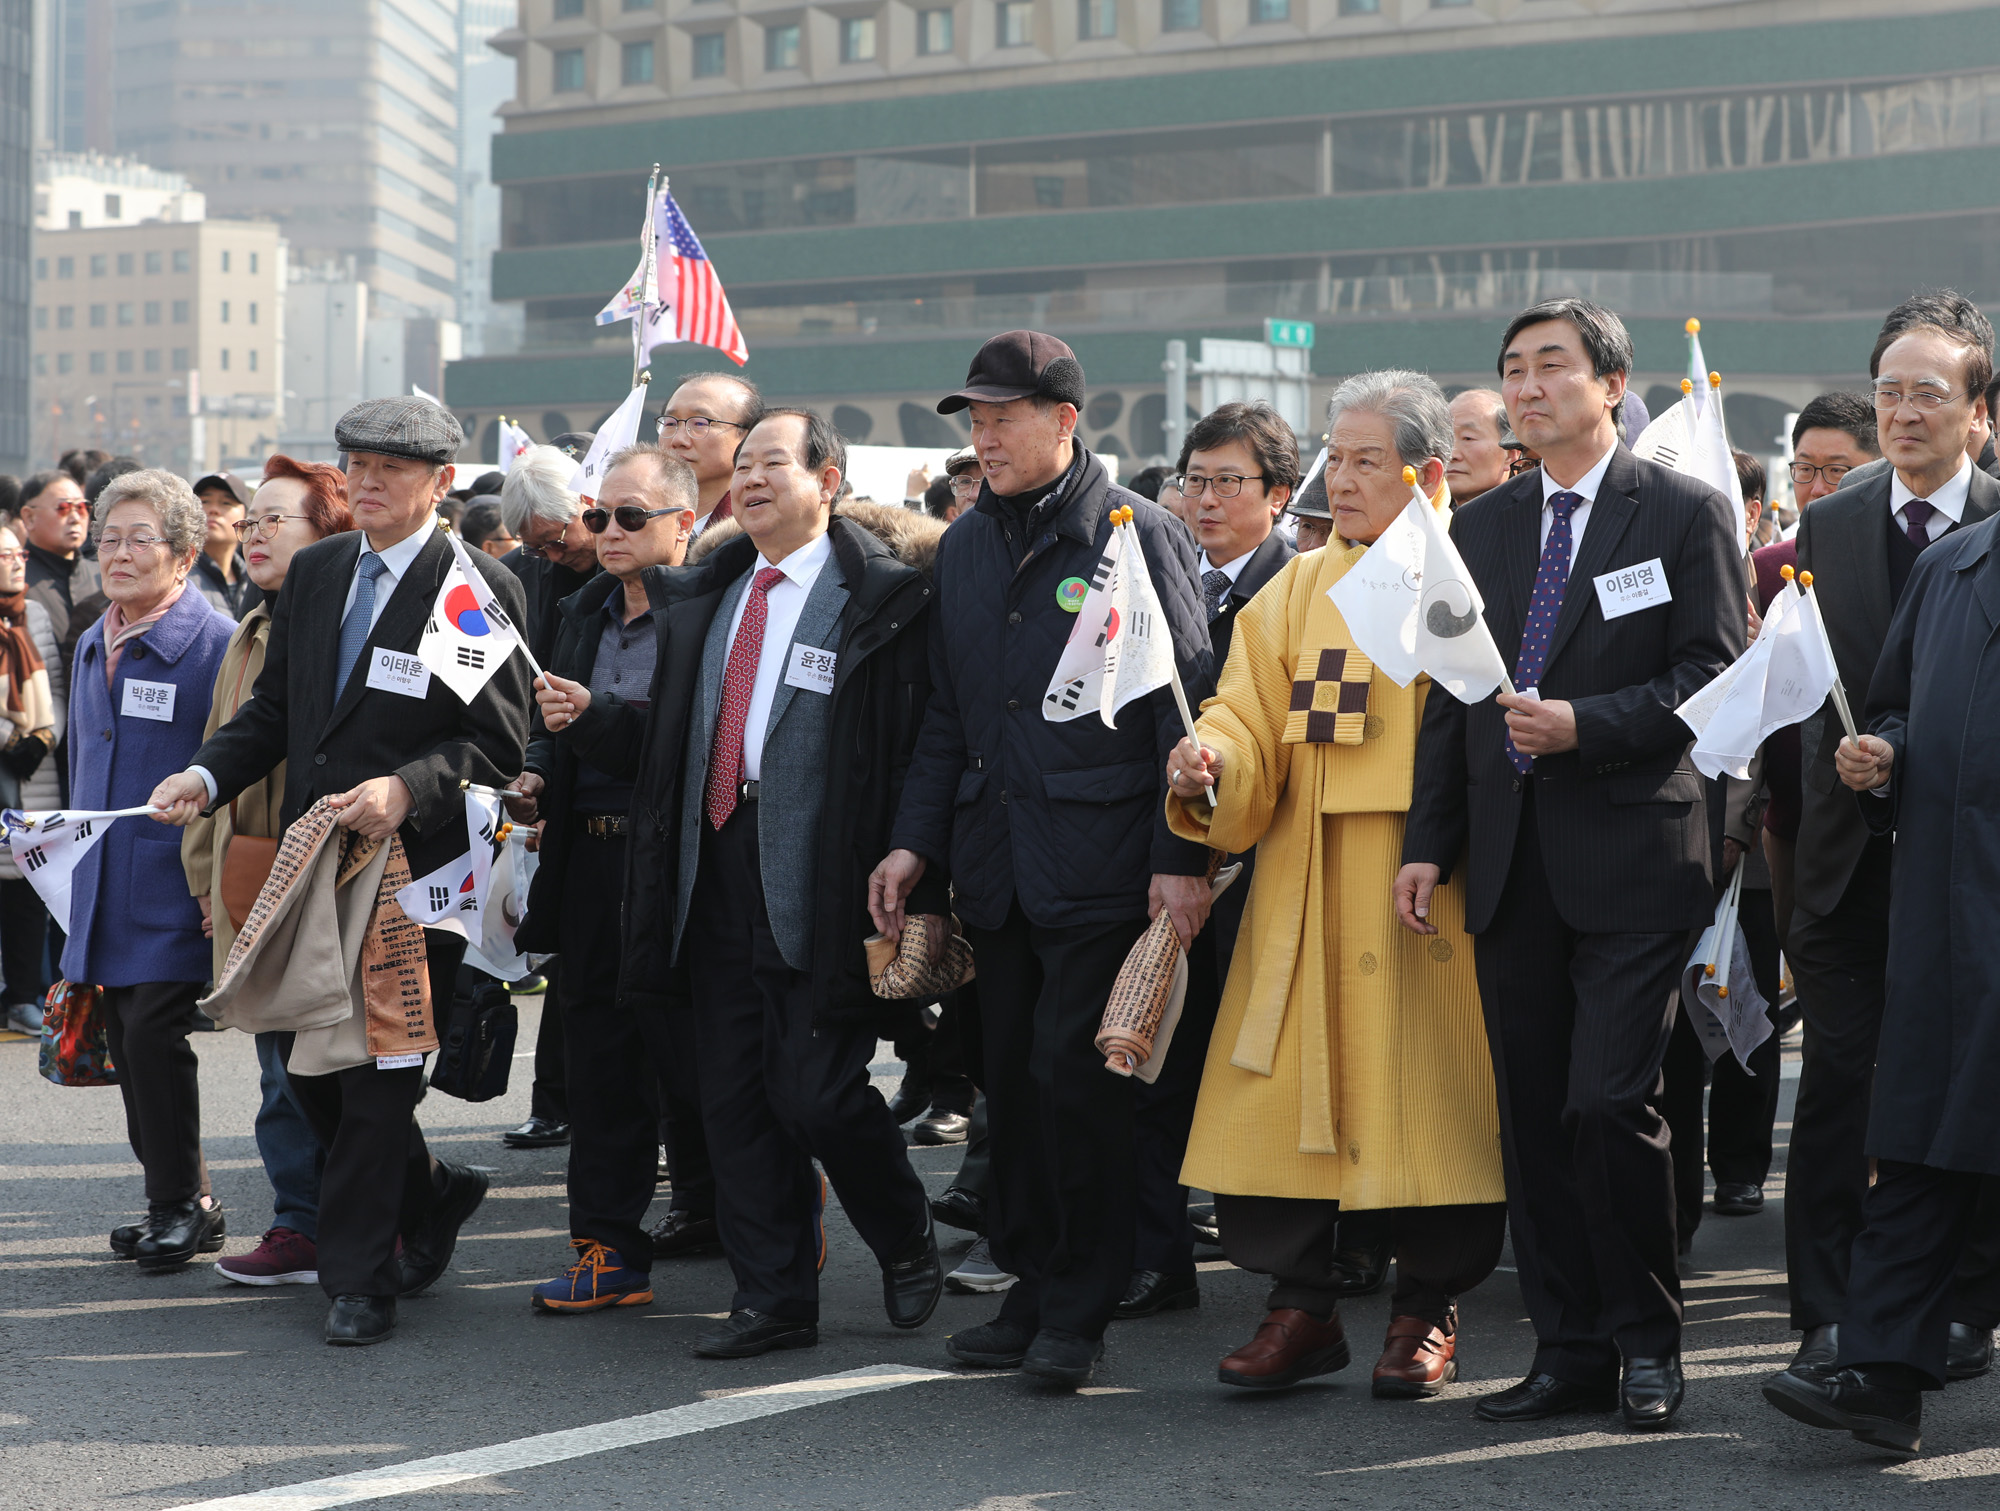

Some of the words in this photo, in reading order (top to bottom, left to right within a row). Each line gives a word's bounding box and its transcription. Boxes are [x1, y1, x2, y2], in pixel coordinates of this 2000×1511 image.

[1606, 566, 1655, 593] 이회영
[381, 655, 424, 678] 이태훈
[132, 686, 169, 704] 박광훈
